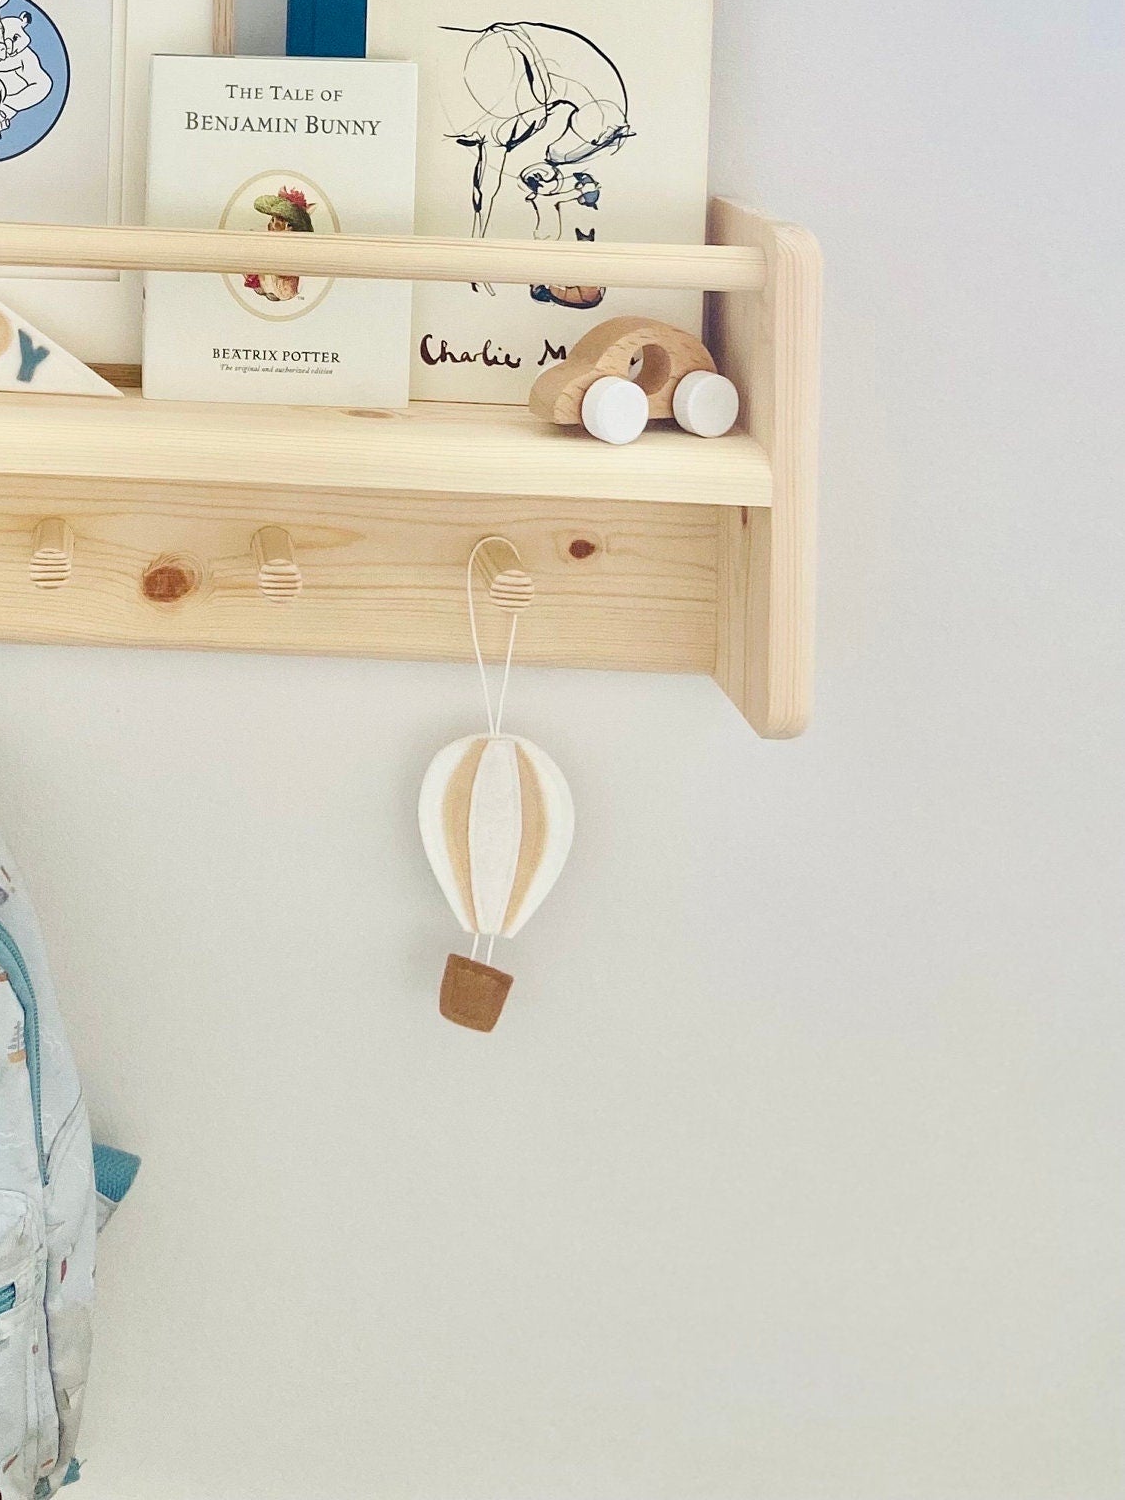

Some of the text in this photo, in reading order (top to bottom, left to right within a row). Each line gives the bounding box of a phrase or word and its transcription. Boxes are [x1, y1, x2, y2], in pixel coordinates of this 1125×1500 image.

[225, 84, 343, 102] THE TALE OF
[185, 111, 382, 136] BENJAMIN BUNNY
[212, 348, 340, 363] BEATRIX POTTER
[419, 333, 522, 369] Charlie
